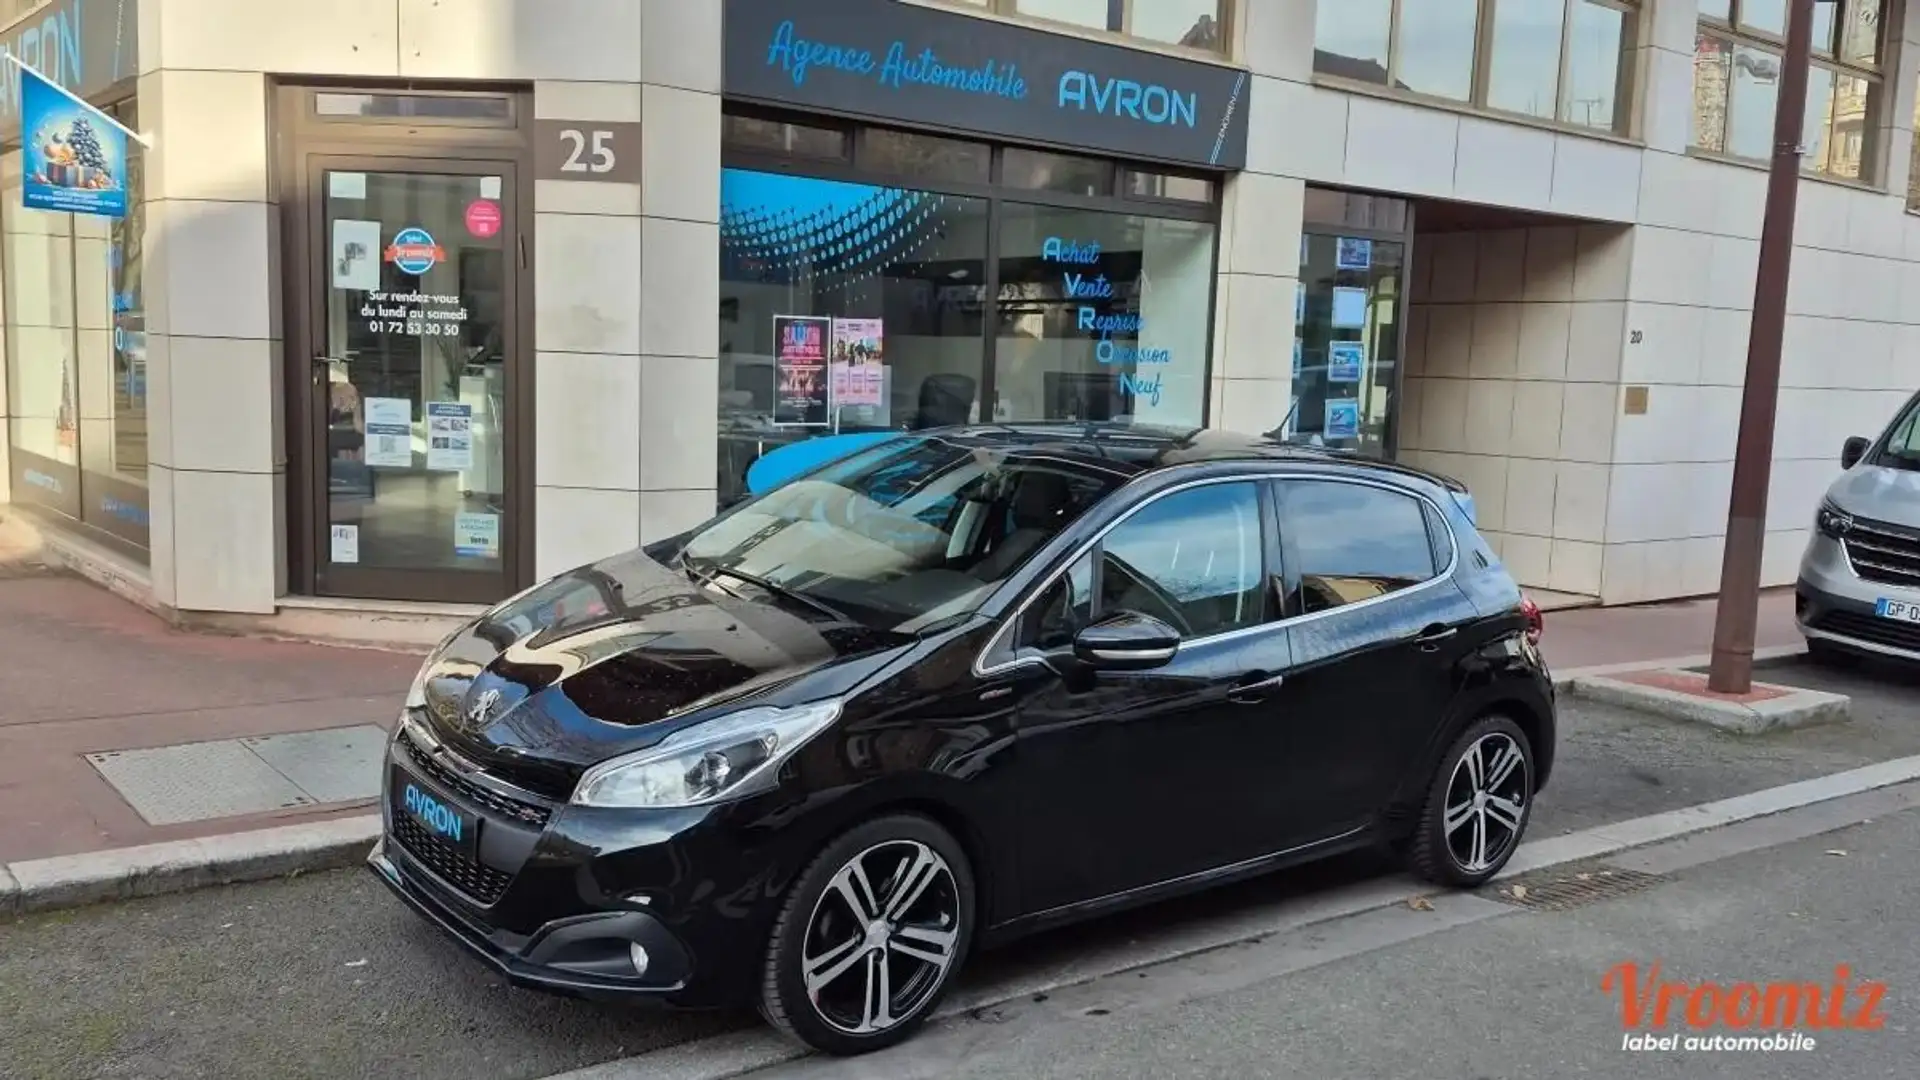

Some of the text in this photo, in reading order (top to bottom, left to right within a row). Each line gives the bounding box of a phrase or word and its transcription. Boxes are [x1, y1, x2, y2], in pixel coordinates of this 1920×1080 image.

[767, 20, 1026, 98] Agence Automobile
[1058, 70, 1197, 128] AVRON
[560, 129, 615, 173] 25
[1043, 236, 1100, 265] Achat
[369, 288, 459, 304] Sur rendez-vous
[1063, 272, 1114, 298] Vente
[361, 303, 467, 320] du lundi au samedi
[1078, 307, 1146, 341] Reprise
[369, 321, 459, 336] 01 72 53 30 50
[1630, 330, 1643, 344] 20
[1120, 371, 1164, 407] Neuf
[1886, 601, 1920, 620] GP-0
[405, 783, 461, 842] AVRON
